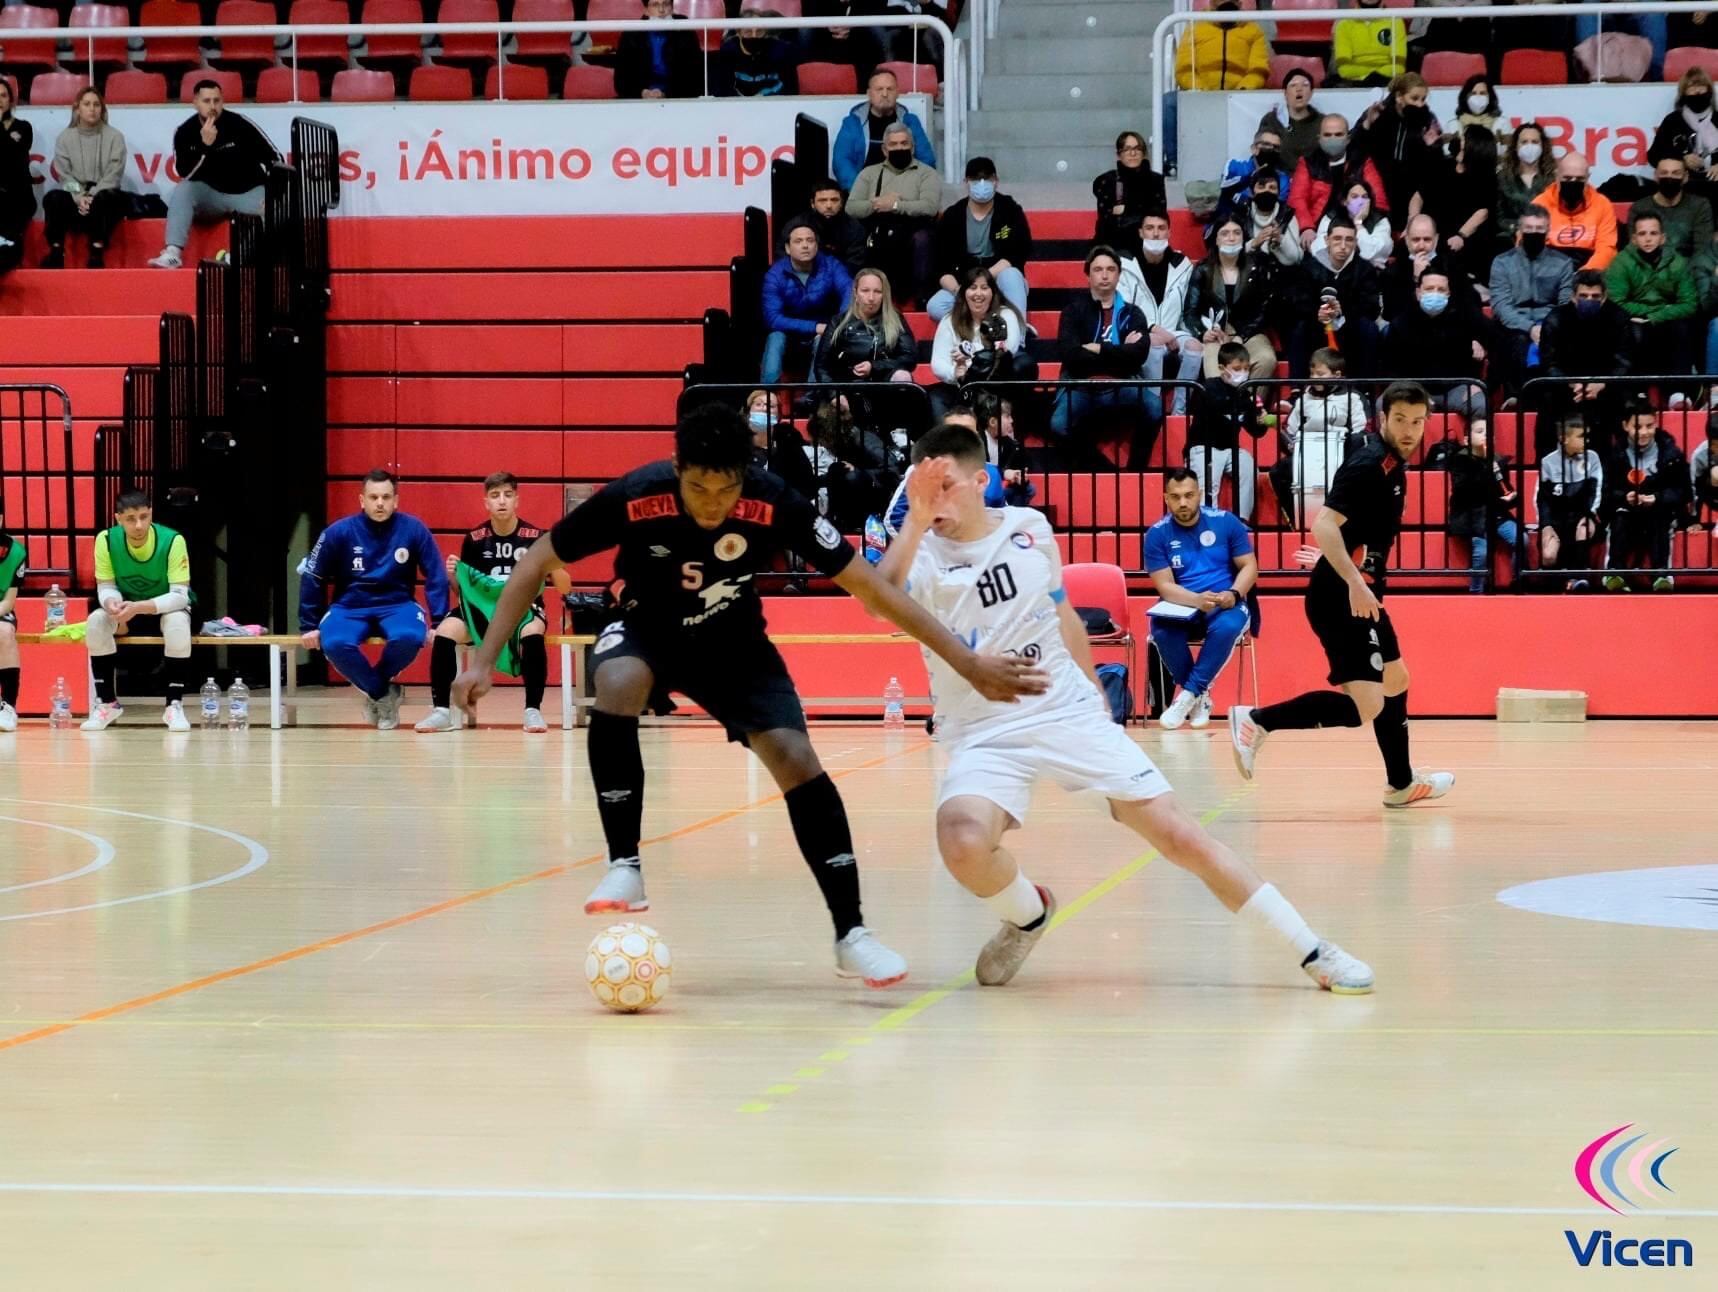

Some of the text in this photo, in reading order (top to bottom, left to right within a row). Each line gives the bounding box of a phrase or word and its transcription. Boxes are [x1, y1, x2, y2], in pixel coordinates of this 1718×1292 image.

[398, 129, 592, 181] ¡Ánimo
[495, 542, 513, 559] 10
[682, 561, 704, 590] 5
[976, 562, 1018, 608] 80
